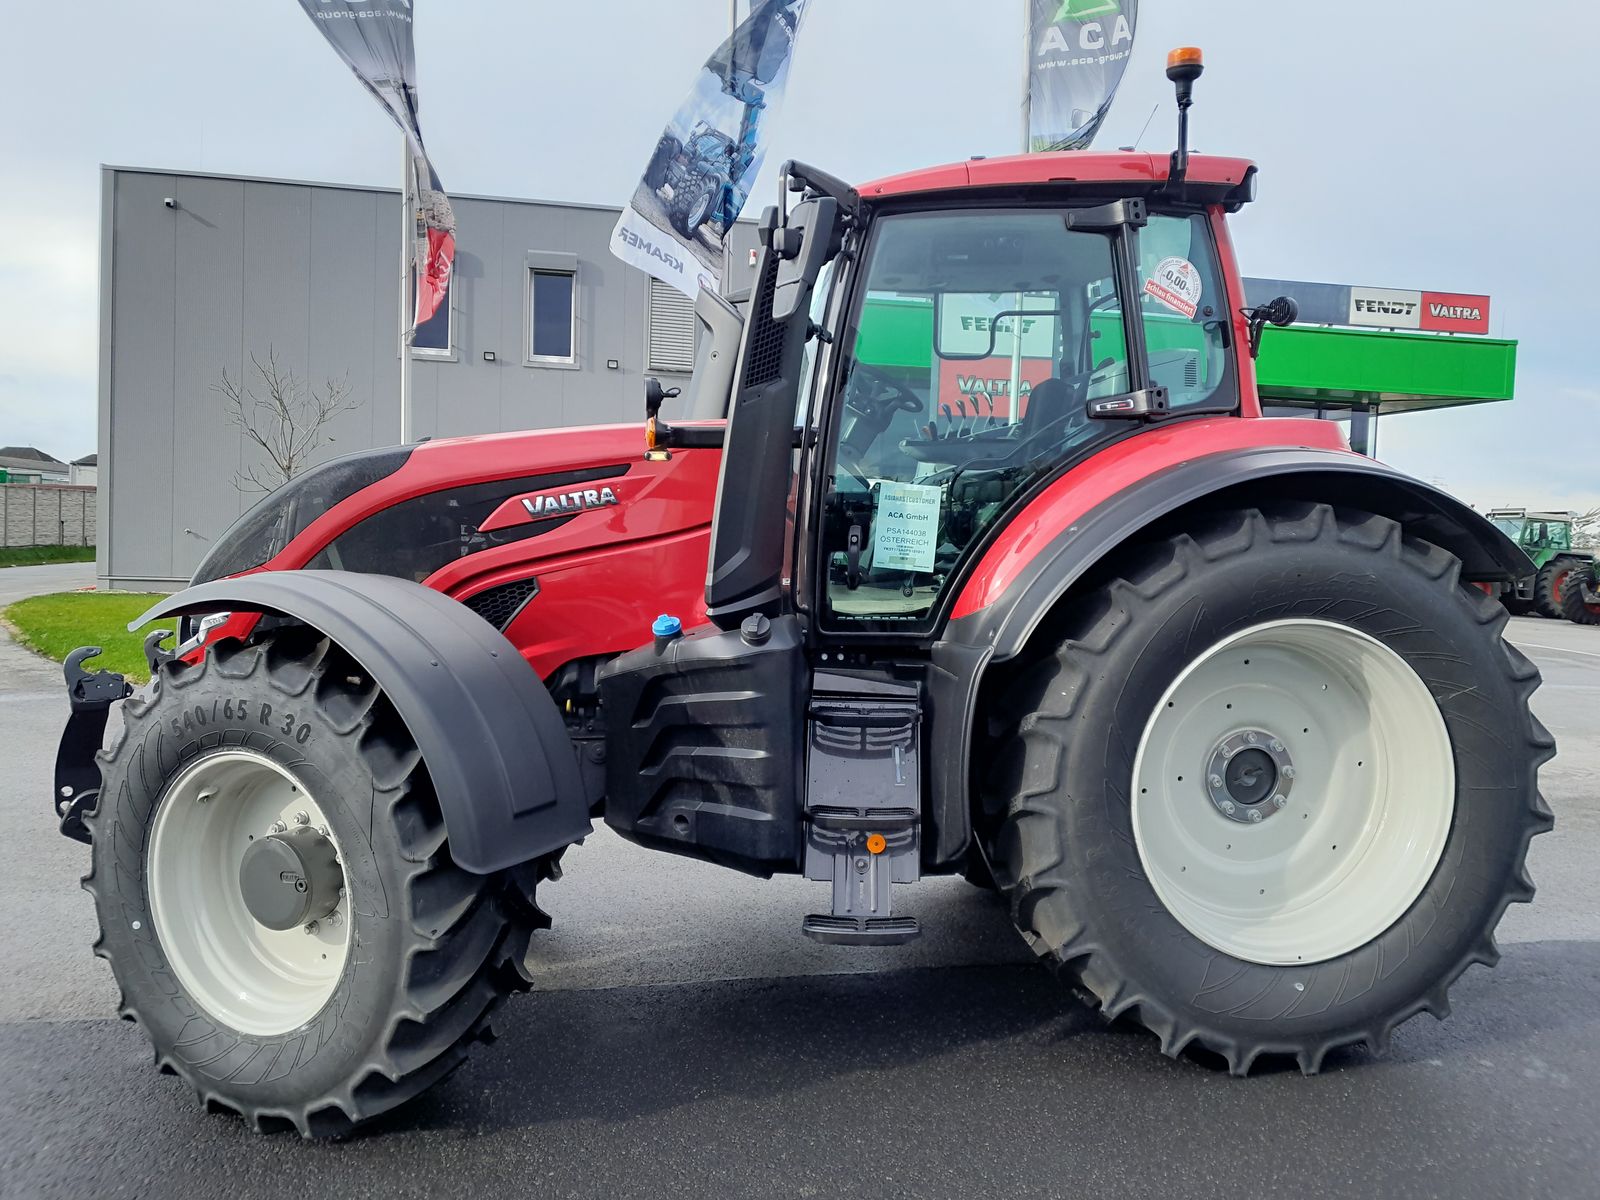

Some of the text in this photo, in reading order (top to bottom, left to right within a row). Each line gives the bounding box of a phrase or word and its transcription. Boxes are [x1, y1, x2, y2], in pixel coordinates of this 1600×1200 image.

[1038, 14, 1132, 56] ACA
[1354, 299, 1416, 315] FENDT
[1429, 302, 1481, 320] VALTRA
[957, 375, 1034, 397] VALTA
[522, 487, 618, 518] VALTRA
[888, 511, 928, 521] ACA GmbH
[171, 699, 312, 745] 540/65 R 30
